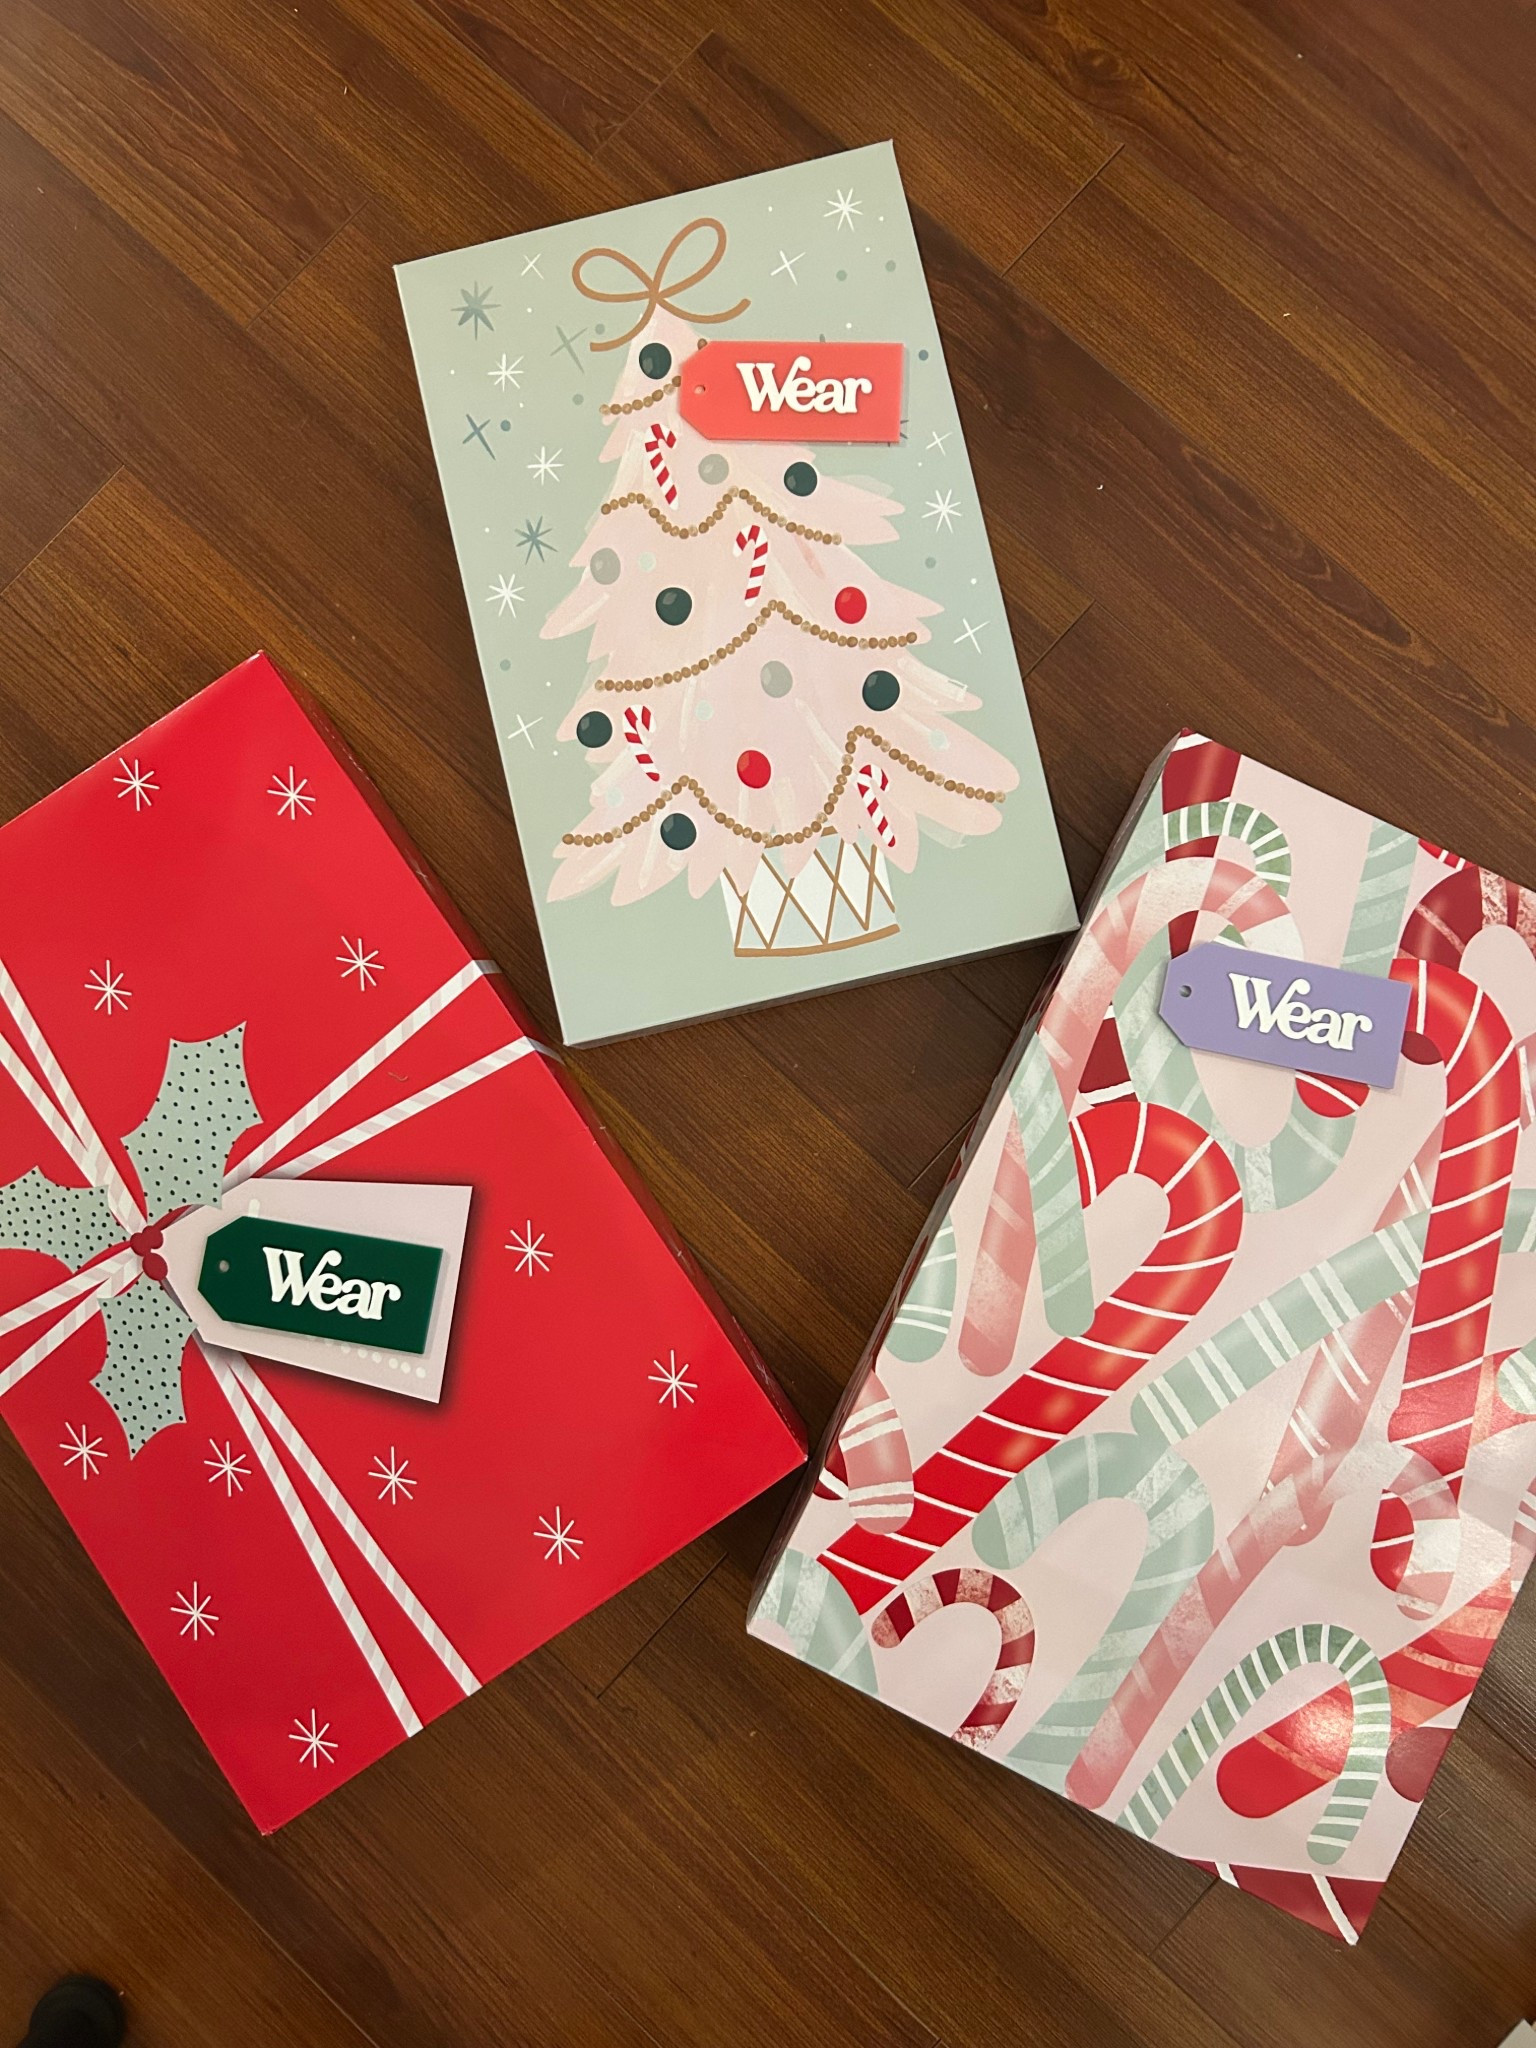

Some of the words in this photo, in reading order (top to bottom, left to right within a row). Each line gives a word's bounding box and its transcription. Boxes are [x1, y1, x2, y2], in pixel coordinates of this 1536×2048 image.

[736, 356, 872, 414] Wear
[1228, 972, 1373, 1051] Wear
[262, 1246, 401, 1321] Wear
